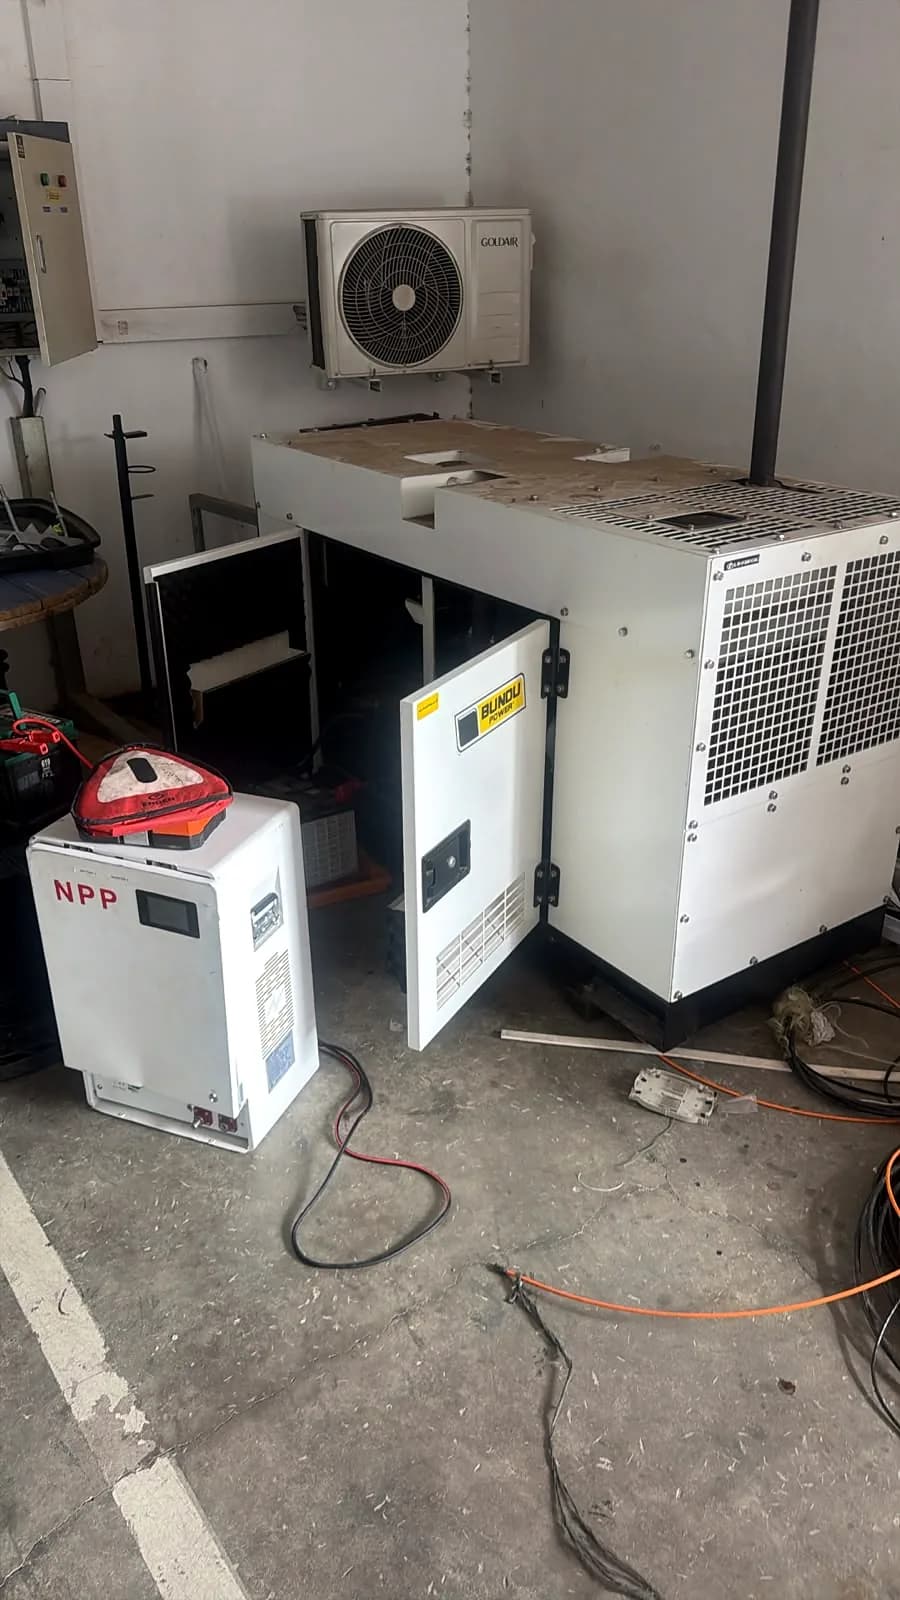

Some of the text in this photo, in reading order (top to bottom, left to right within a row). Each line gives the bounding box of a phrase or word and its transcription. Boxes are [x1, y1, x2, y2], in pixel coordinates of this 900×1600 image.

[480, 236, 519, 248] GOLDAIR
[481, 682, 521, 720] BUNDU
[489, 703, 513, 725] POWER
[53, 879, 117, 909] NPP
